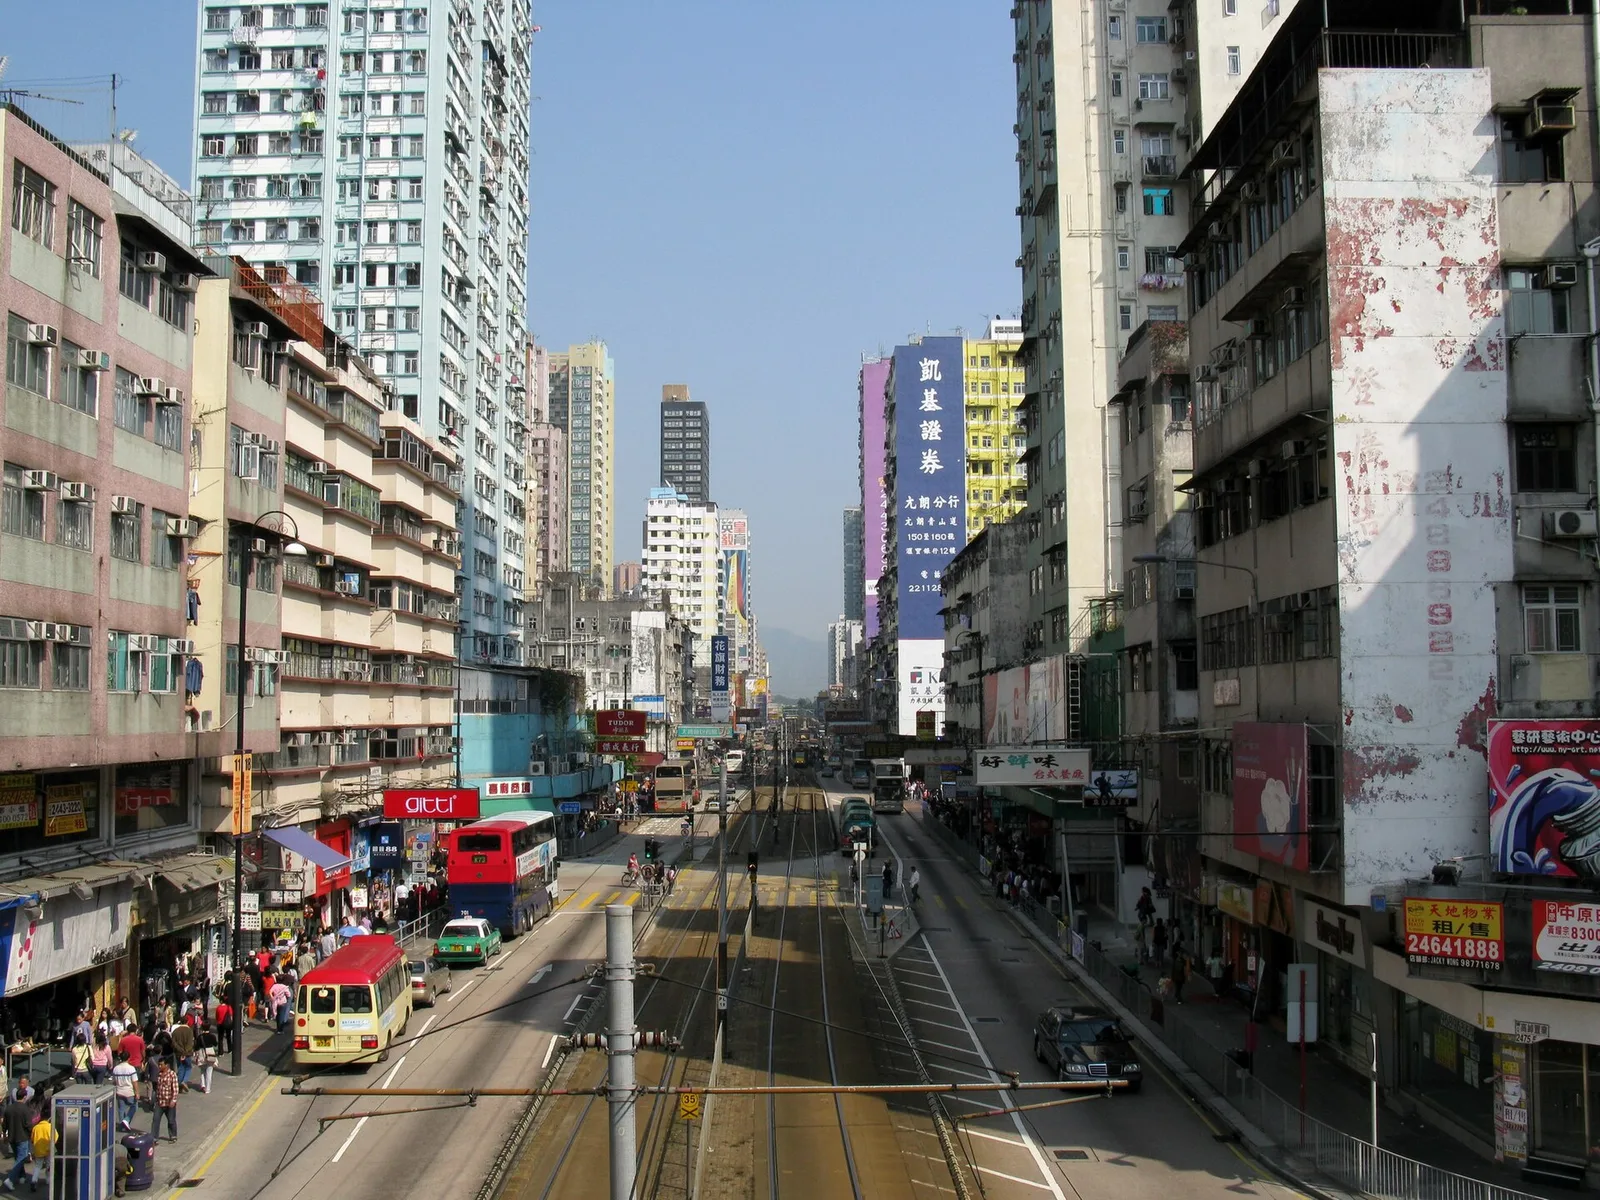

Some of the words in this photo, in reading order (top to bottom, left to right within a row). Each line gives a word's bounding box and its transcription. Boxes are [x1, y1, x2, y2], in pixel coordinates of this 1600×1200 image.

[918, 357, 944, 475] 凱基證券
[905, 495, 960, 509] 元朗分行
[715, 640, 726, 687] 花旗財務
[1429, 904, 1497, 920] 天地物業
[1432, 920, 1490, 937] 租/售
[1408, 934, 1499, 959] 24641888
[1460, 959, 1500, 970] 98771678
[1537, 961, 1588, 972] 2409
[684, 1095, 696, 1104] 35
